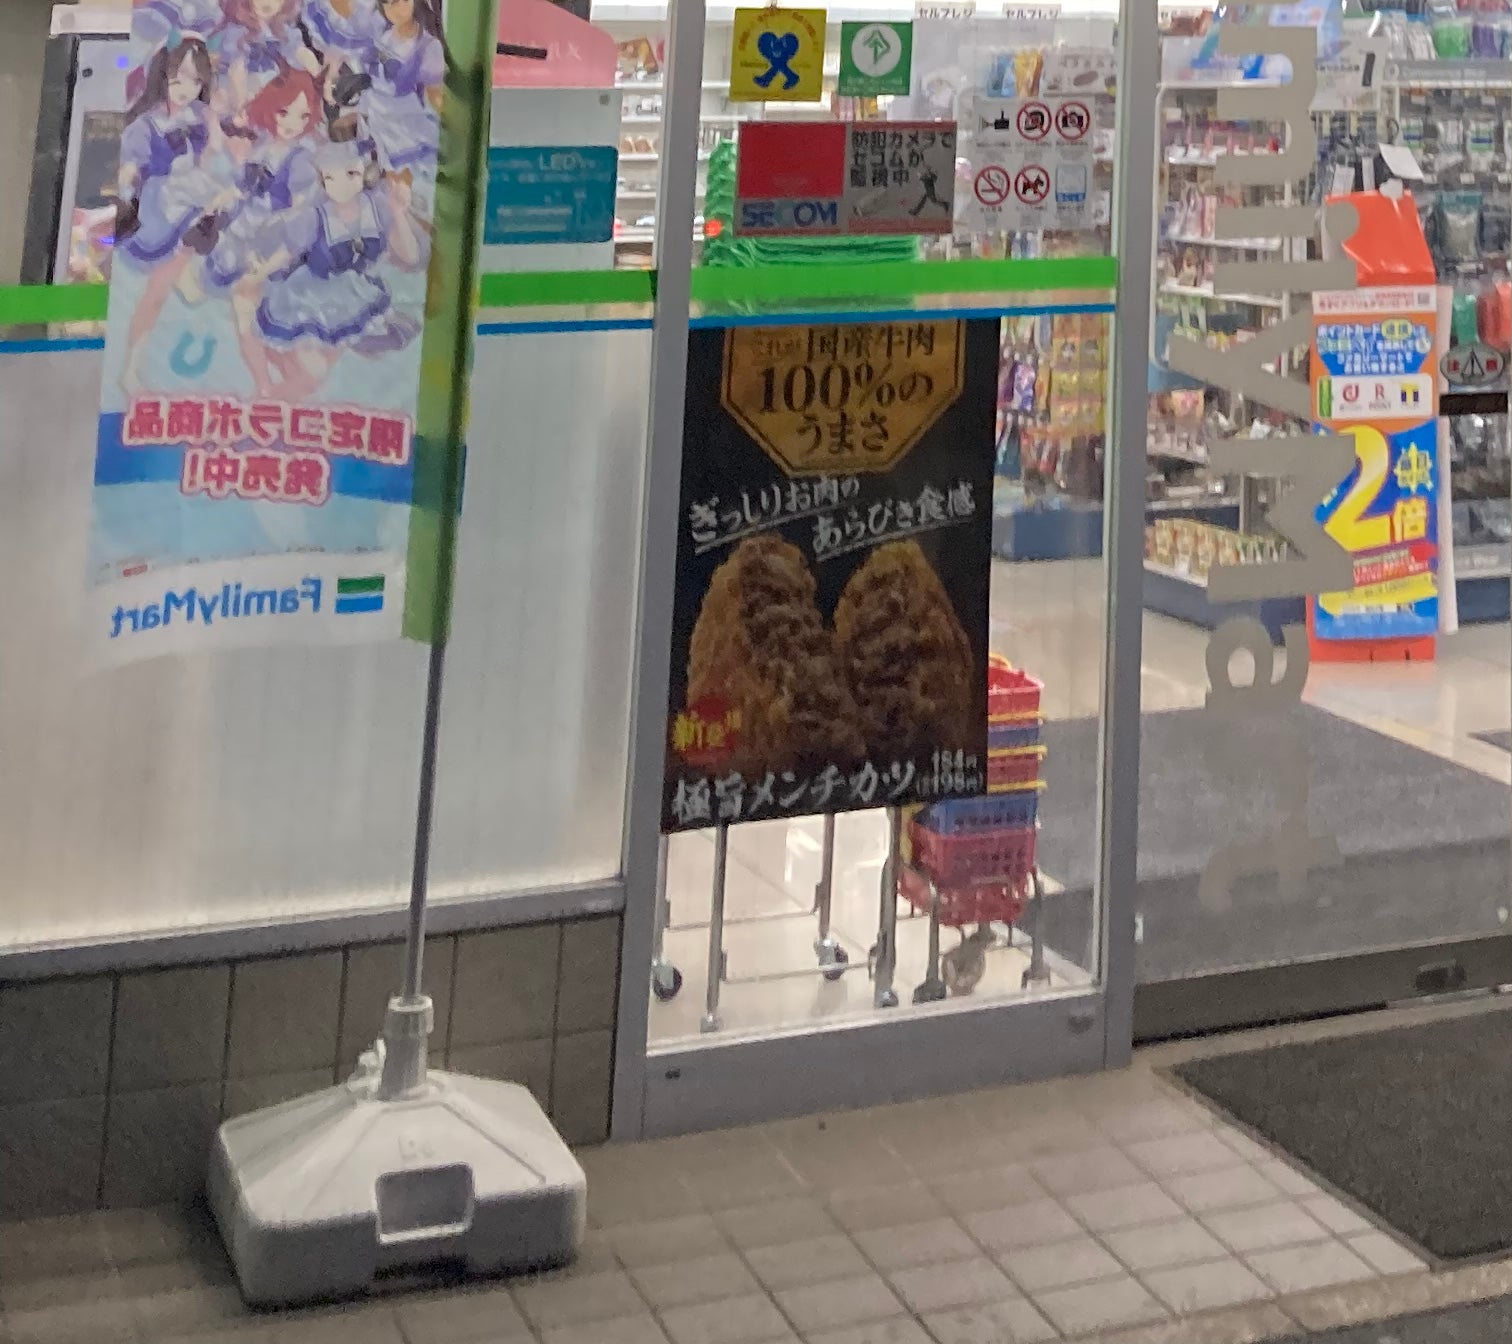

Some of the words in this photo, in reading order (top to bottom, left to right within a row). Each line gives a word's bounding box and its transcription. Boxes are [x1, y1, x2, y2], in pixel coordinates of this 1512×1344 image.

[759, 362, 934, 414] 100%の
[796, 409, 890, 455] うまさ
[812, 479, 977, 555] あらびき食感
[672, 760, 916, 825] 極旨メンチカツ
